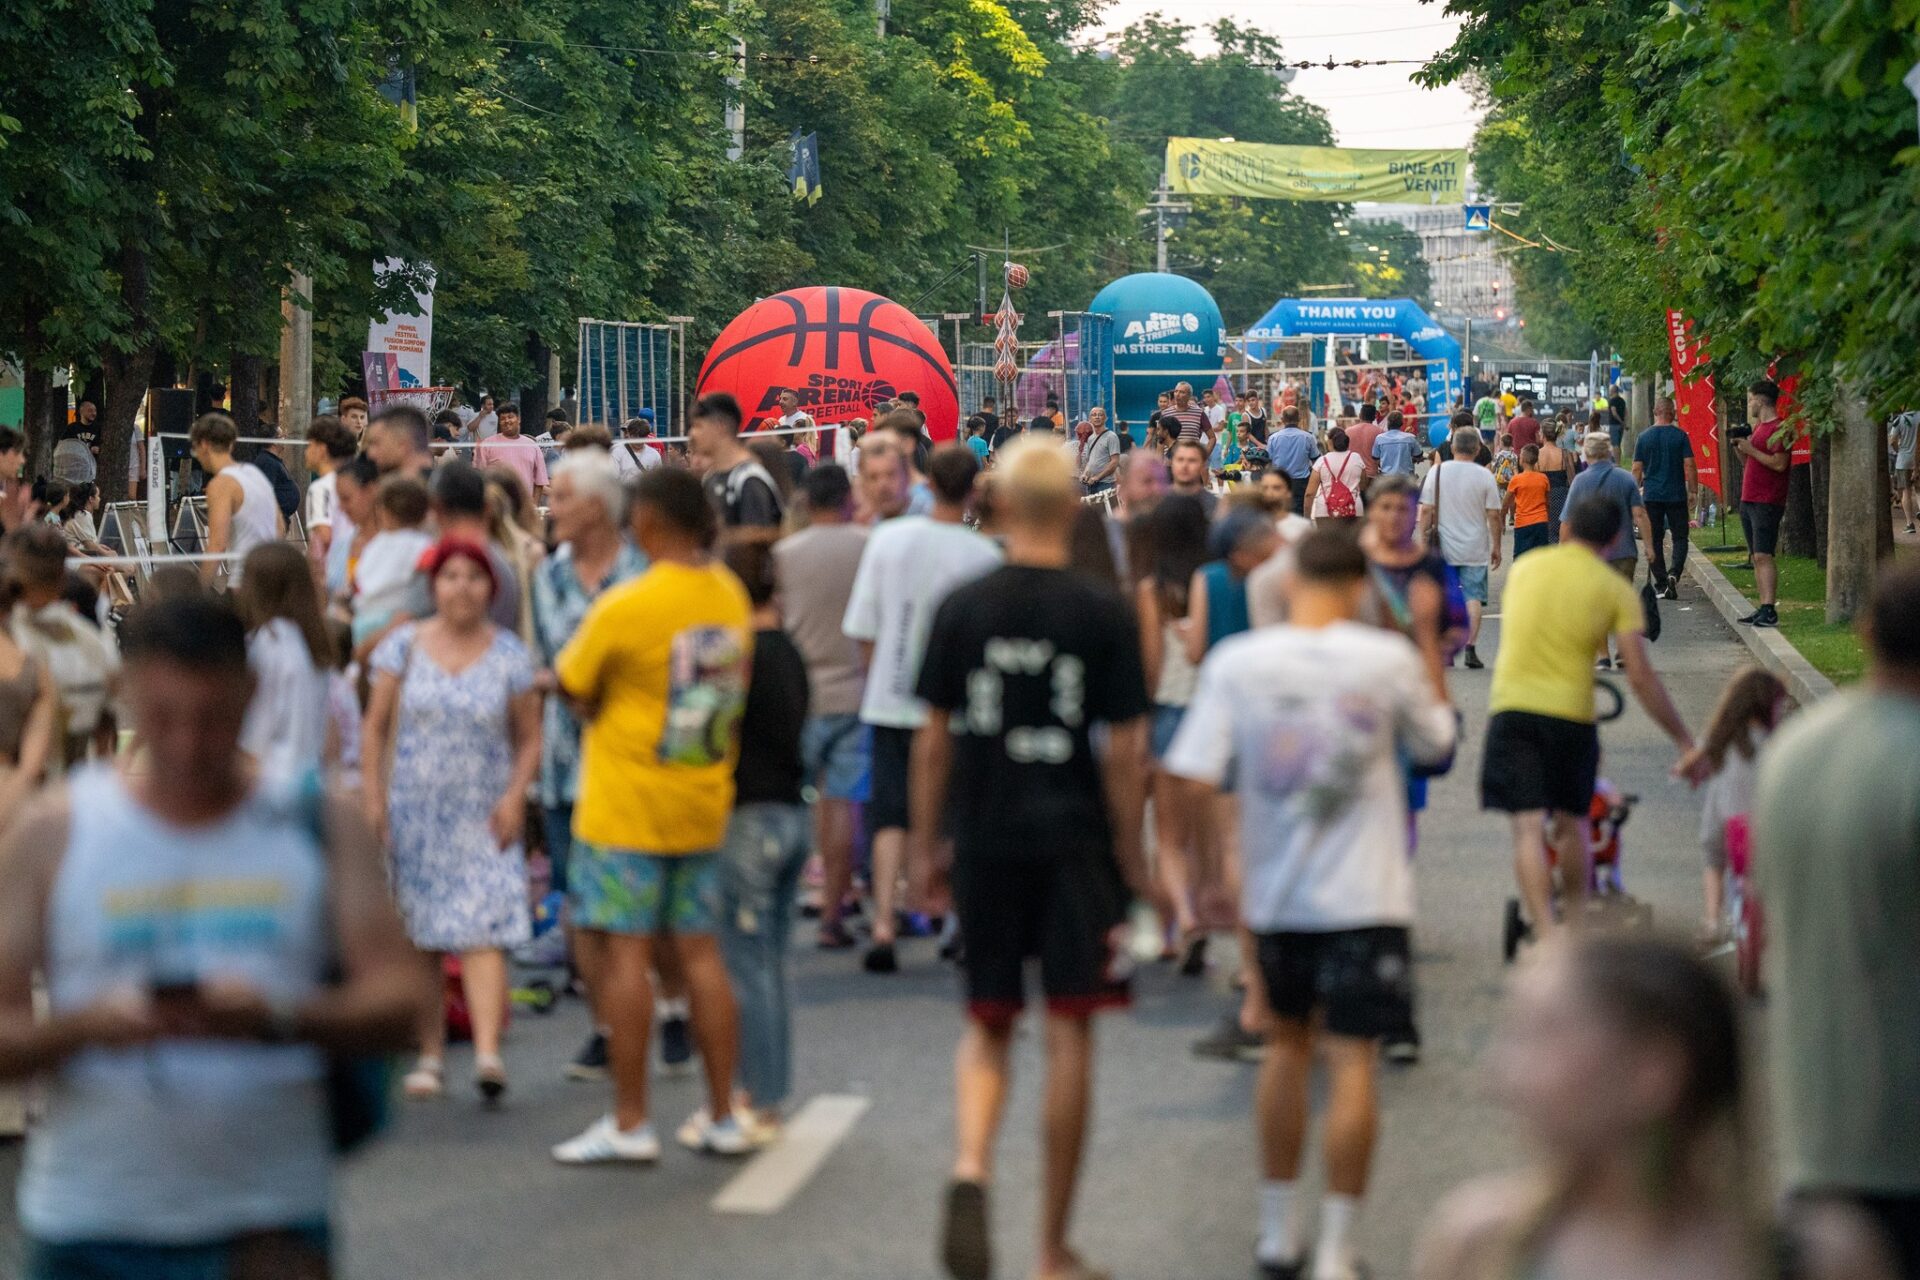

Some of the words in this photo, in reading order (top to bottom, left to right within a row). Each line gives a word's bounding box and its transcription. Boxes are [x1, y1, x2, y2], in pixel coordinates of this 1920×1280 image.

[1388, 161, 1427, 175] BINE
[1403, 177, 1458, 192] VENIT!
[1297, 305, 1357, 319] THANK
[1360, 306, 1397, 319] YOU
[1123, 319, 1182, 339] ARENA
[1129, 343, 1205, 355] STREETBALL
[808, 373, 863, 390] SPORT
[1551, 386, 1575, 397] BCR
